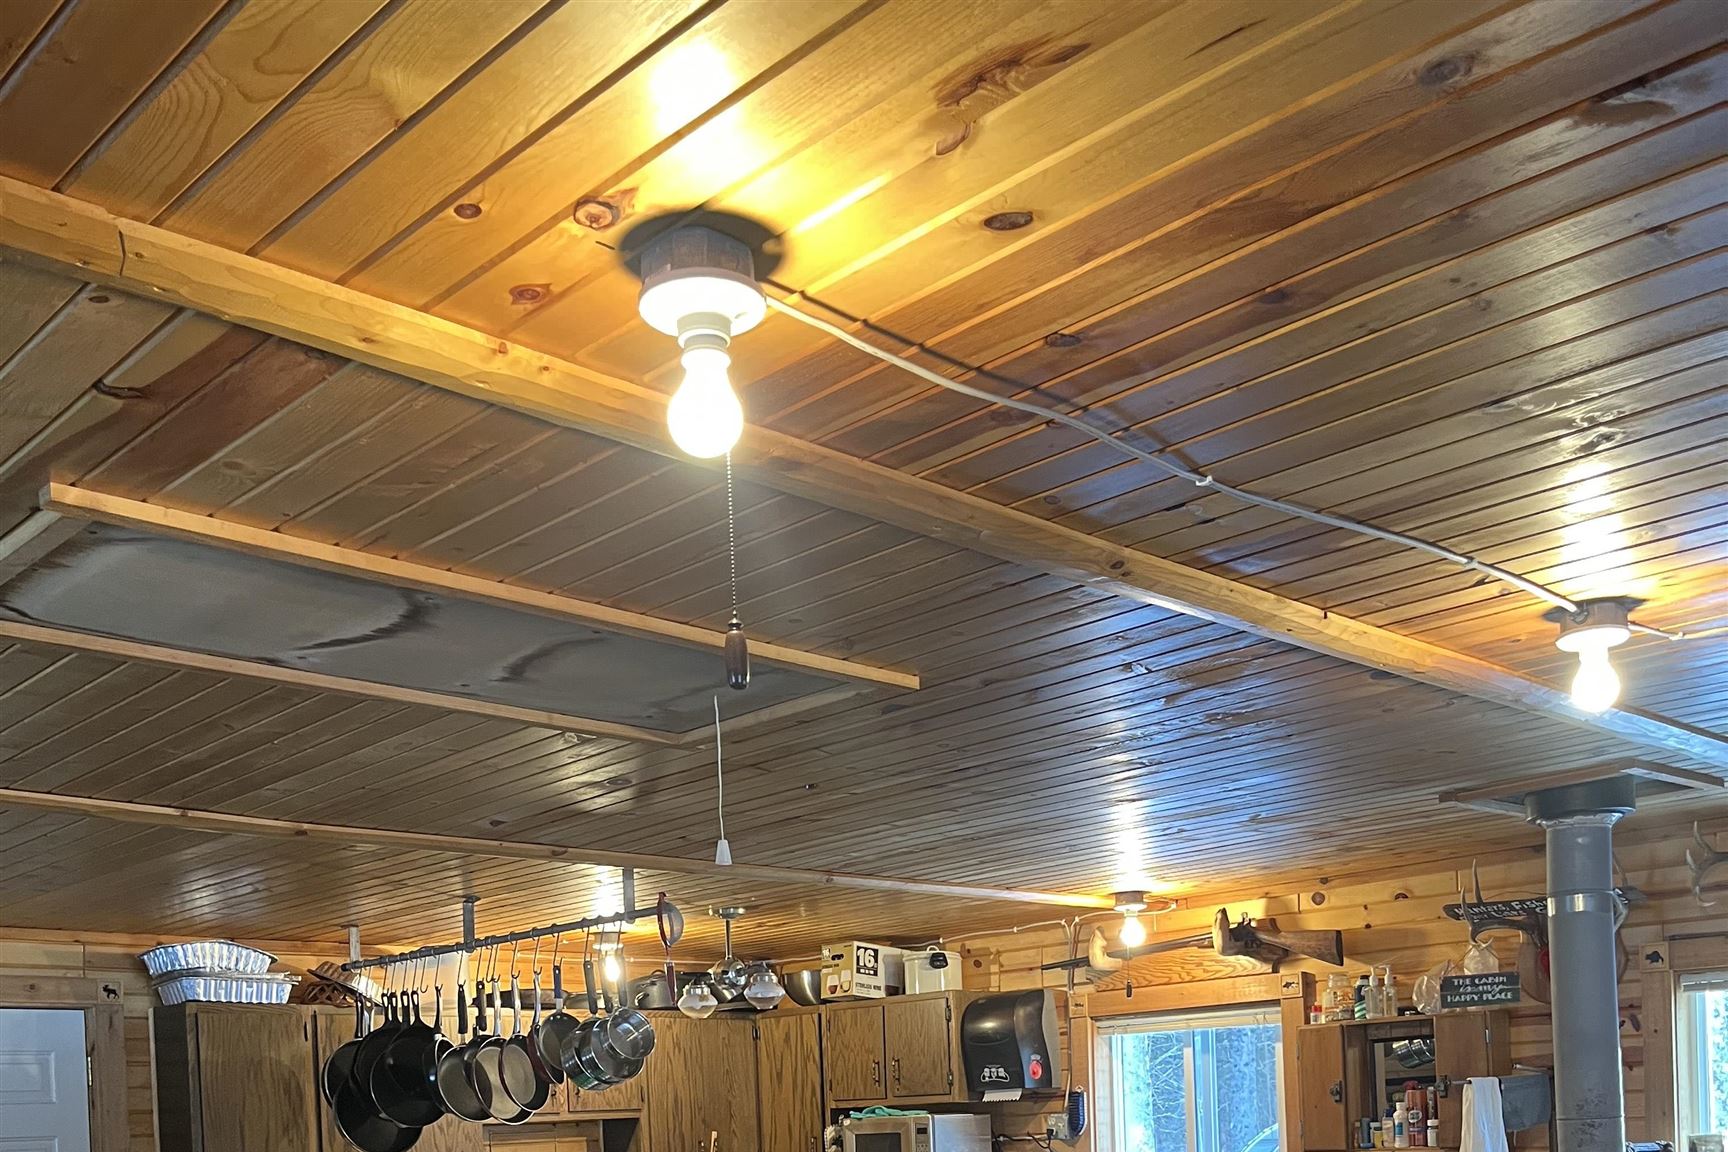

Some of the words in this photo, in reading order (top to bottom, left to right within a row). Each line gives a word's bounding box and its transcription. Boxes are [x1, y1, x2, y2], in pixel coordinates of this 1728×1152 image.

[857, 947, 875, 968] 16
[1475, 976, 1507, 984] CABIN
[1447, 994, 1480, 1002] HAPPY
[1483, 991, 1513, 1000] PLACE
